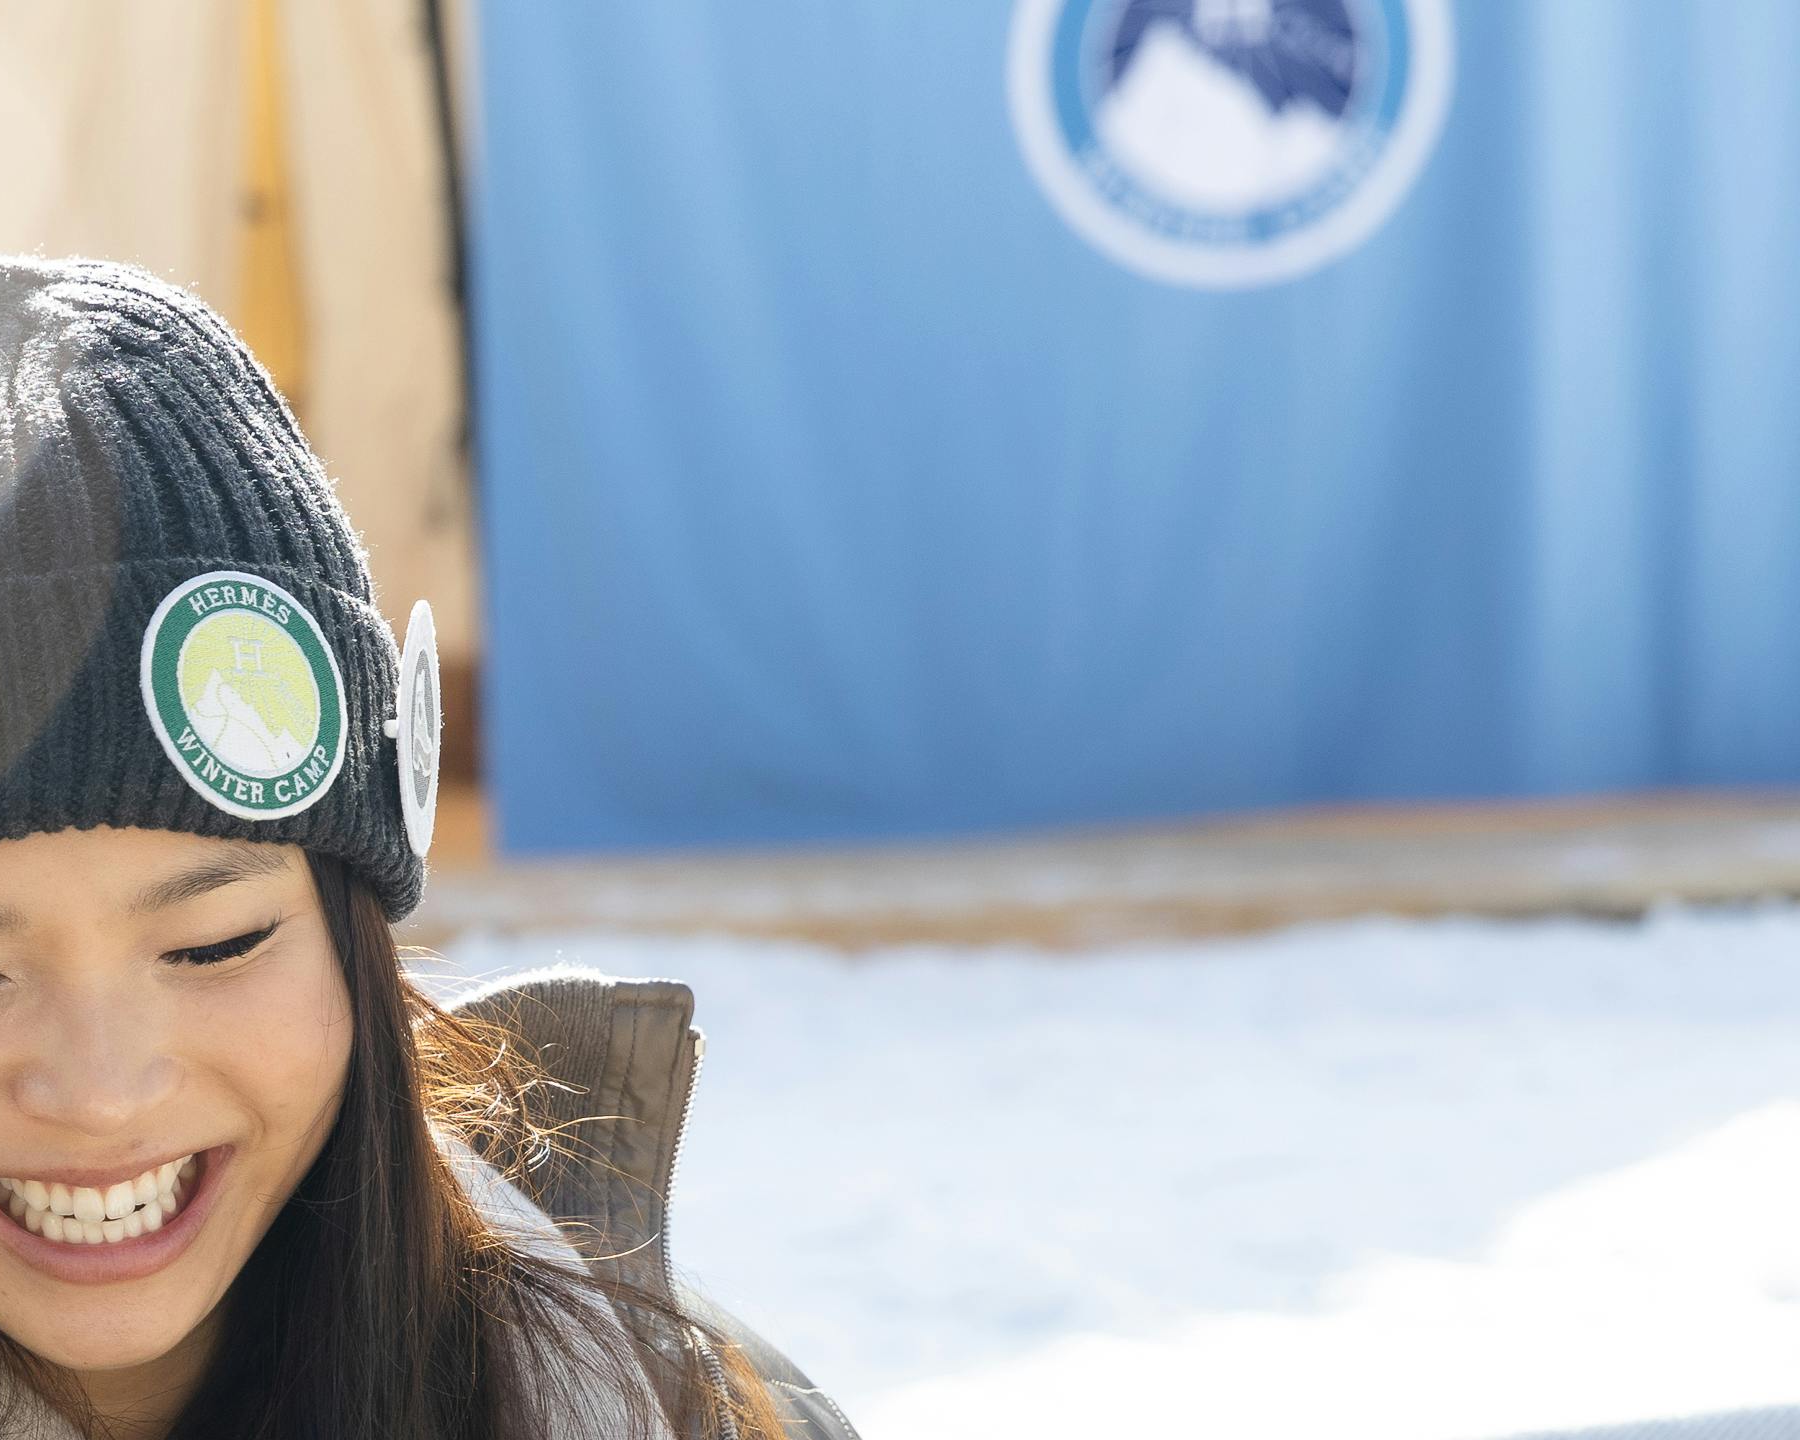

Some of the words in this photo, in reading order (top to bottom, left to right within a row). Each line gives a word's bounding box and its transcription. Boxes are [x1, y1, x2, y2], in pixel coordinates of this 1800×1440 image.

[227, 636, 267, 678] H
[177, 727, 264, 802] WINTER
[274, 745, 331, 802] CAMP
